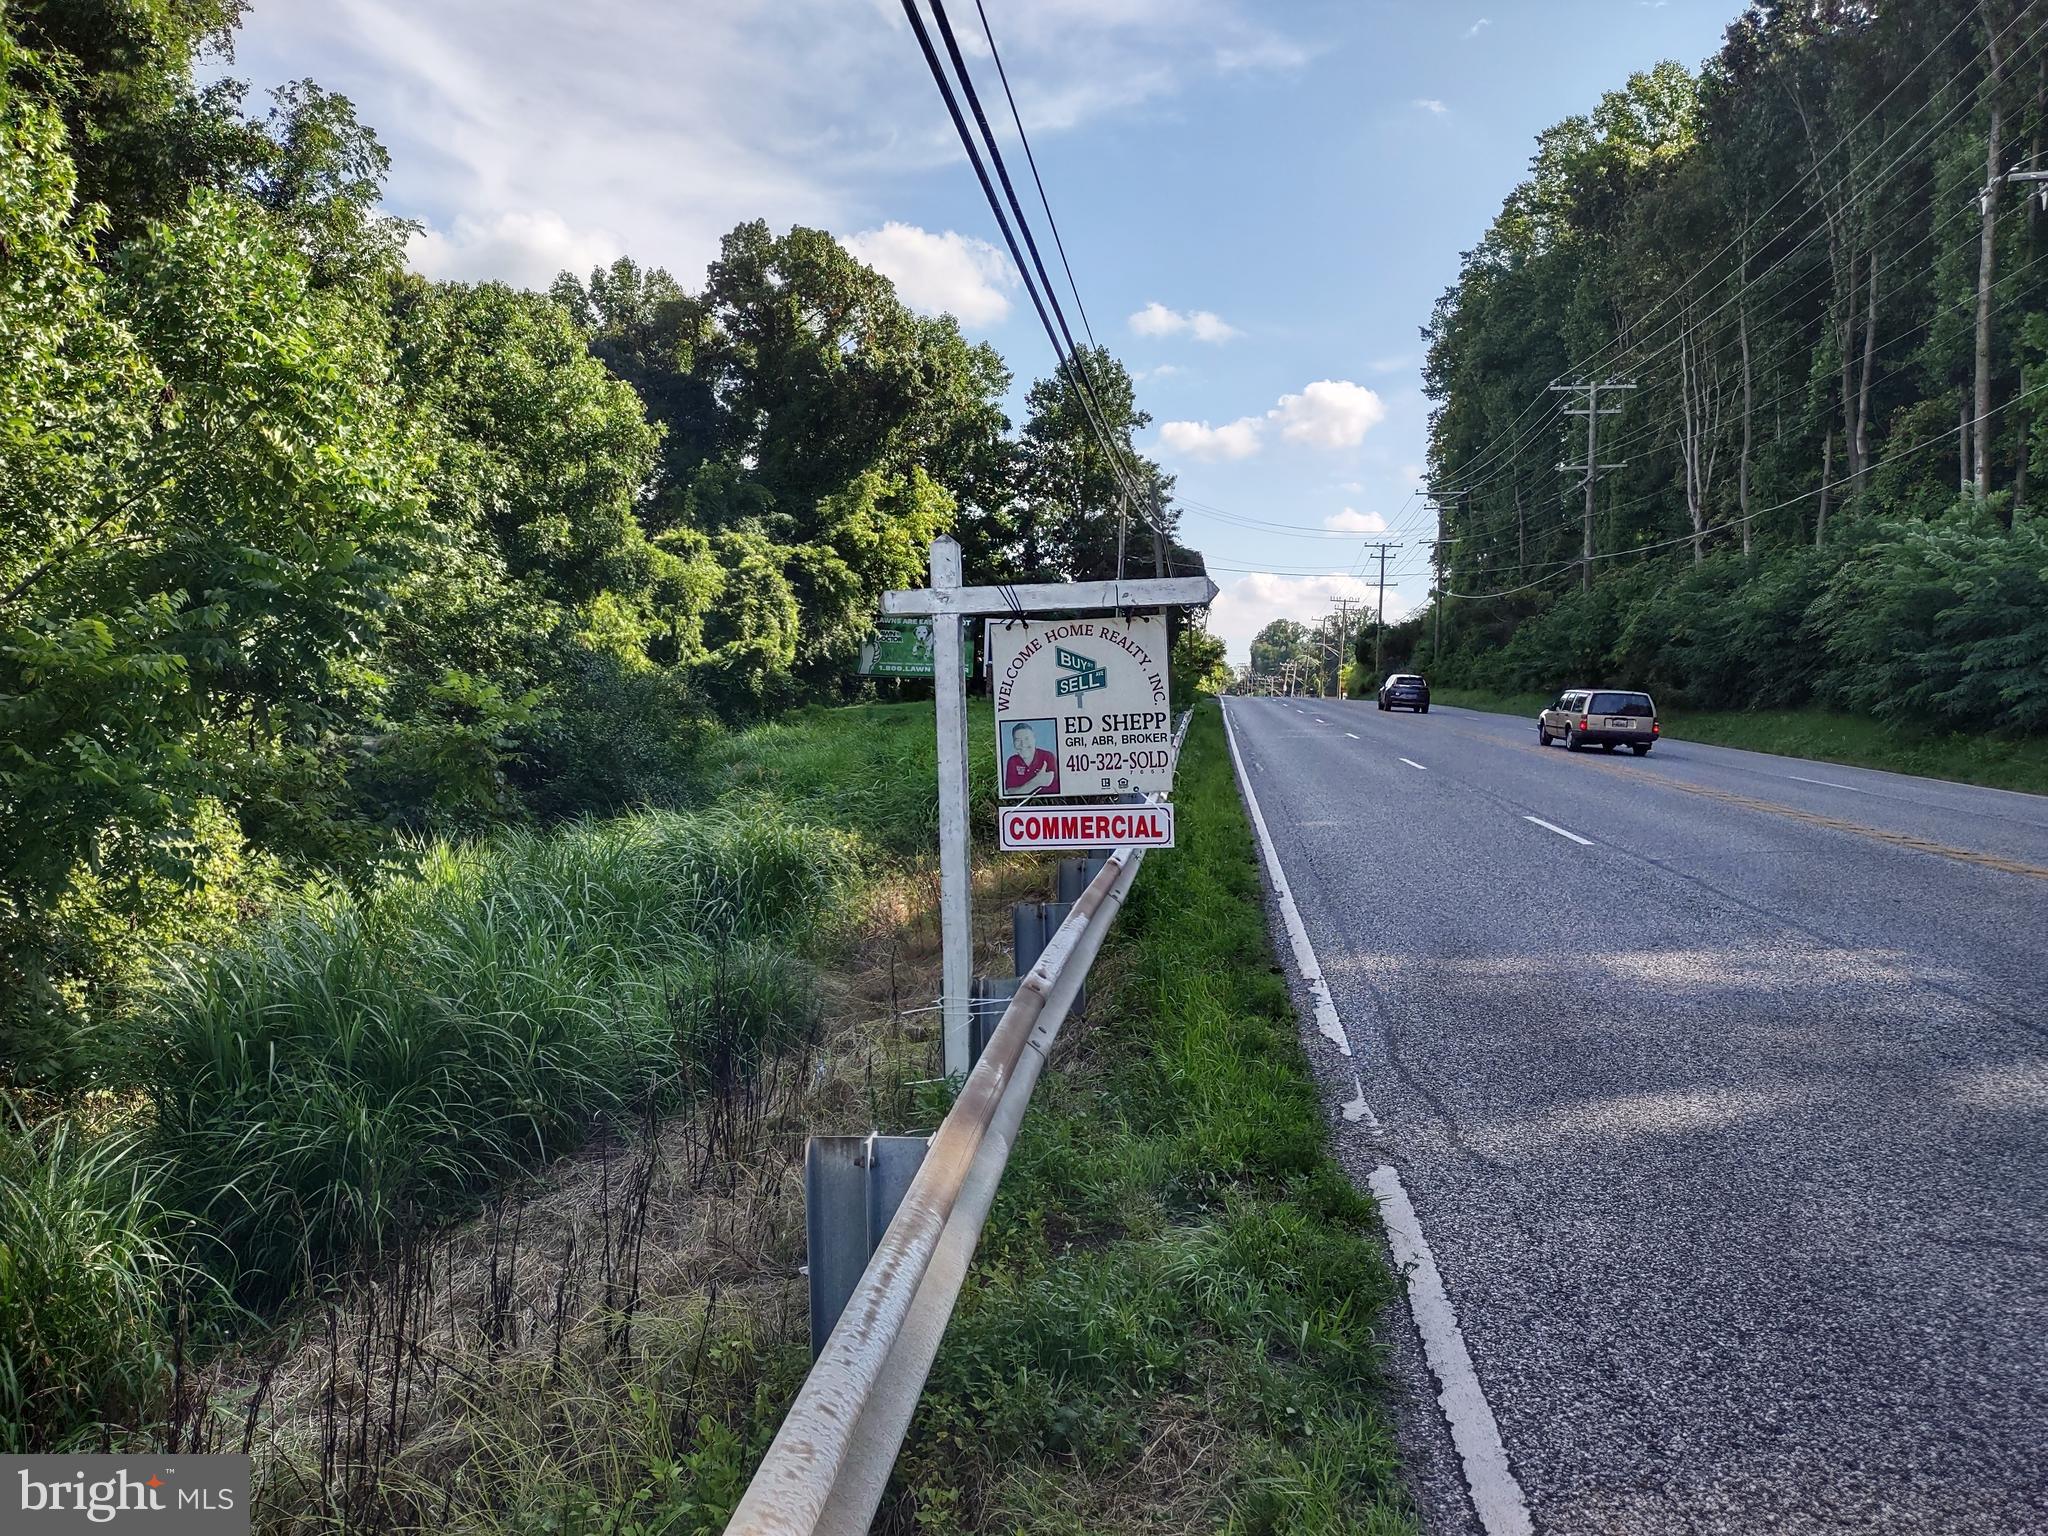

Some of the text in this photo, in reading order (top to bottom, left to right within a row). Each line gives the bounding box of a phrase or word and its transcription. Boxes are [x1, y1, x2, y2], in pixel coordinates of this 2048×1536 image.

[997, 624, 1166, 712] WELCOME HOME REALTY, INC.
[1060, 651, 1088, 670] BUY
[1060, 673, 1100, 694] SELL
[1064, 712, 1167, 734] ED SHEPP
[1065, 733, 1168, 747] GRI, ABR, BROKER
[1066, 750, 1169, 772] 410-322-SOLD
[1009, 815, 1163, 840] COMMERCIAL
